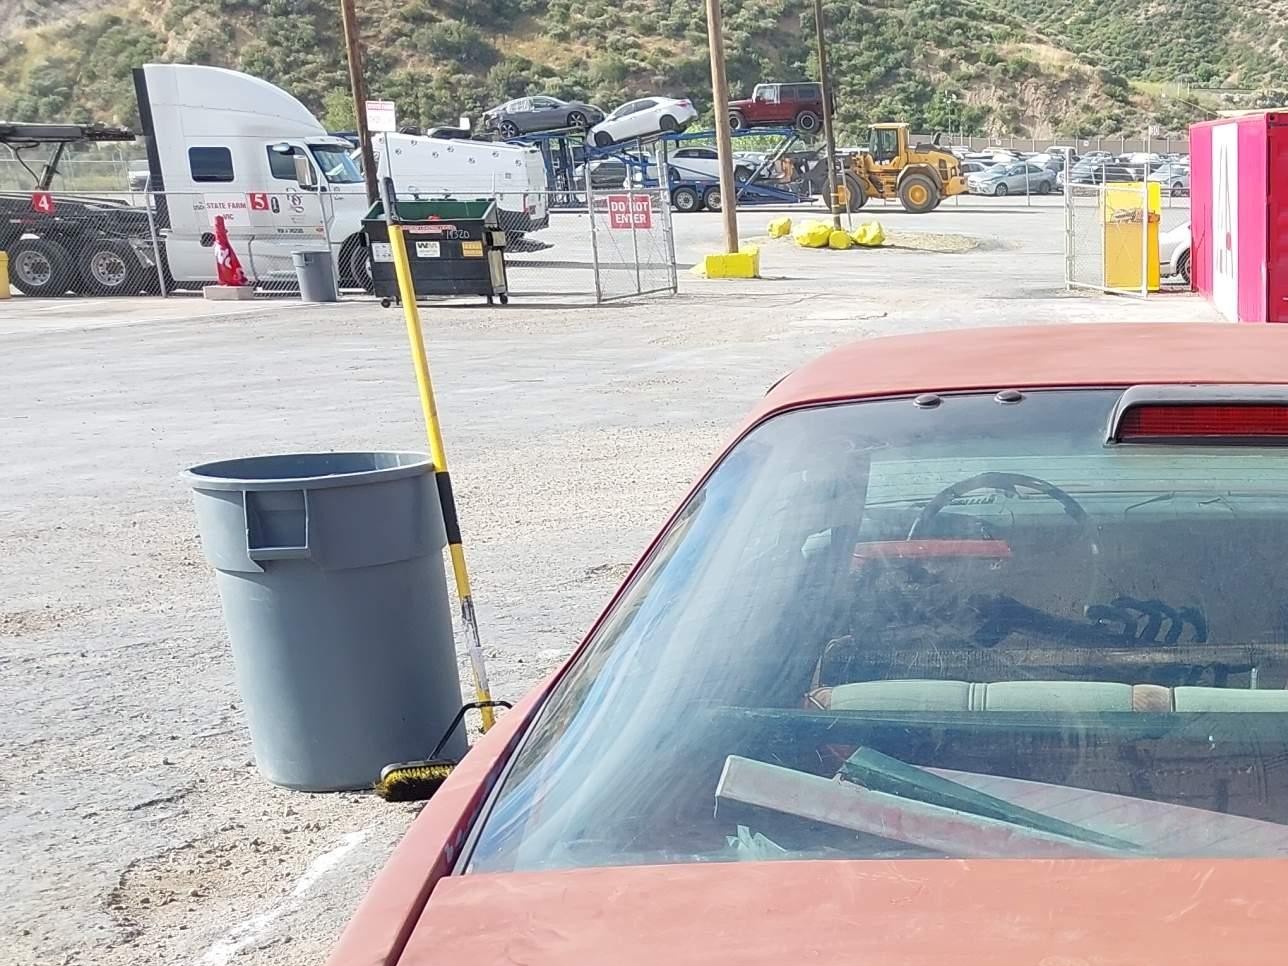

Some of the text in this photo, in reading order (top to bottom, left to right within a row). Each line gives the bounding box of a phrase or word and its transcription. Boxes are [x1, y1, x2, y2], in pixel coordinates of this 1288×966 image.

[38, 195, 49, 211] 4
[255, 194, 265, 209] 5
[611, 201, 625, 212] DO
